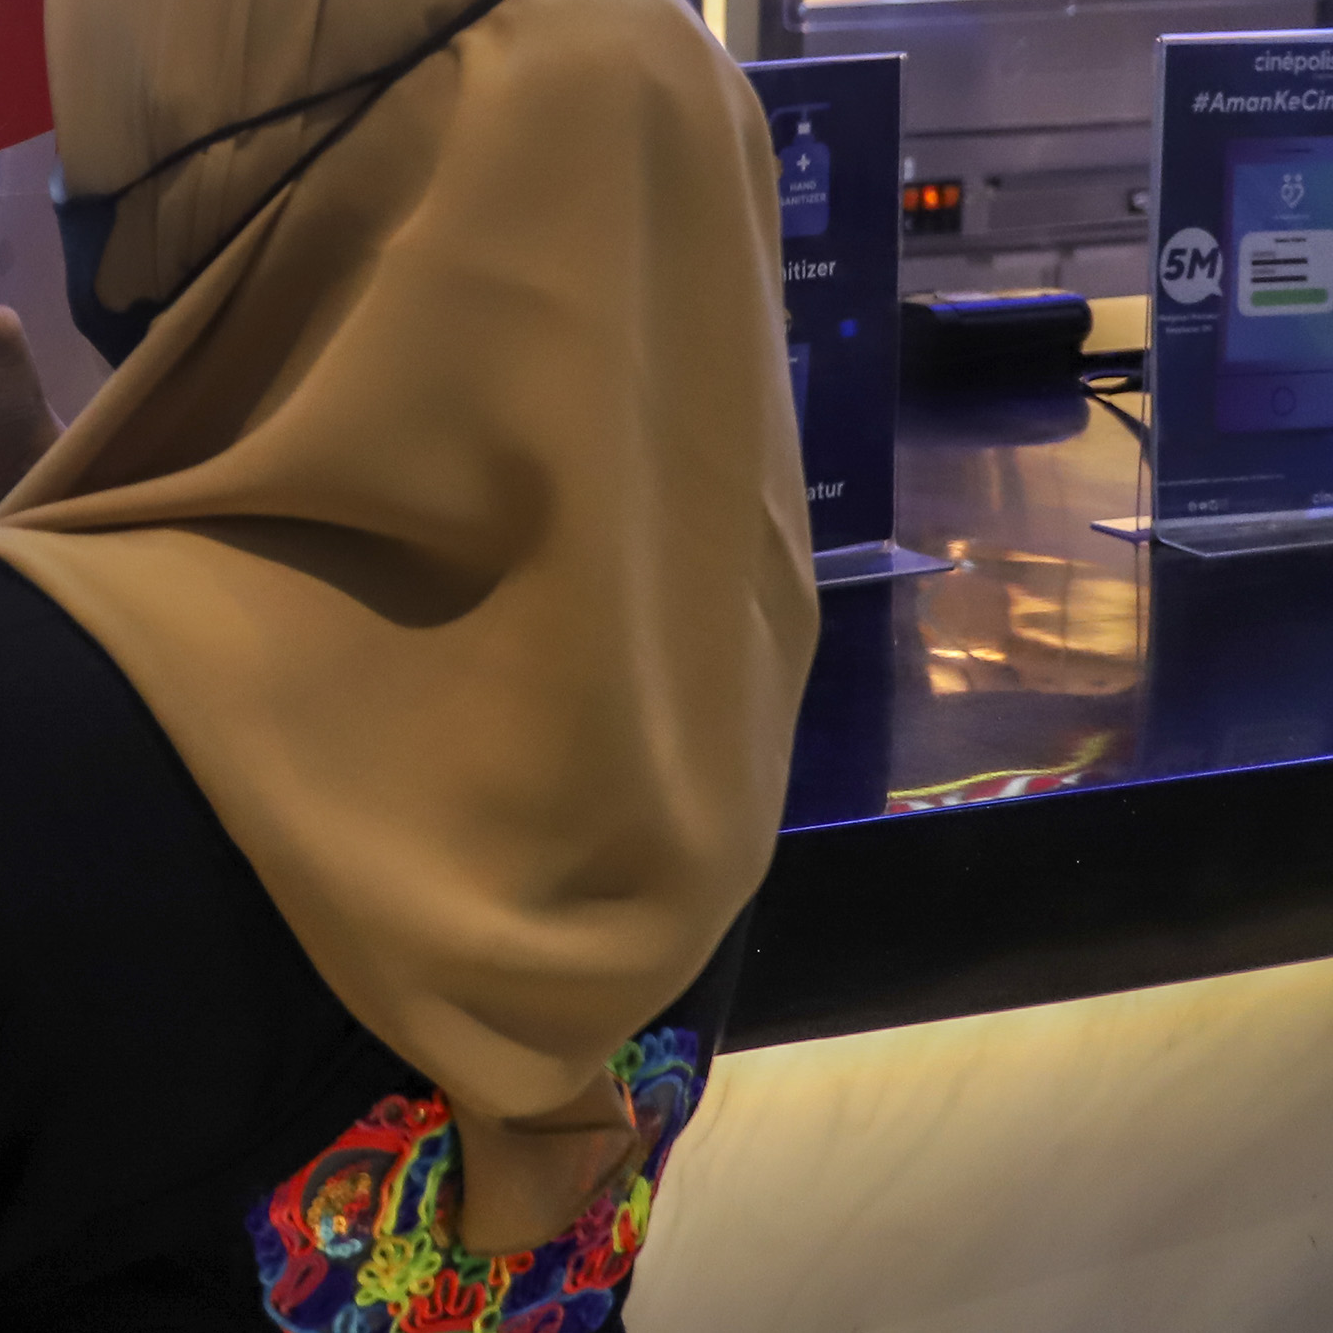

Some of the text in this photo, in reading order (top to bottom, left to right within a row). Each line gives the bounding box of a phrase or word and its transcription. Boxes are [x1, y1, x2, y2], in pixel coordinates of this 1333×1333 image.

[1254, 50, 1333, 77] cinépoli
[1163, 247, 1219, 281] 5M
[808, 481, 845, 501] atur
